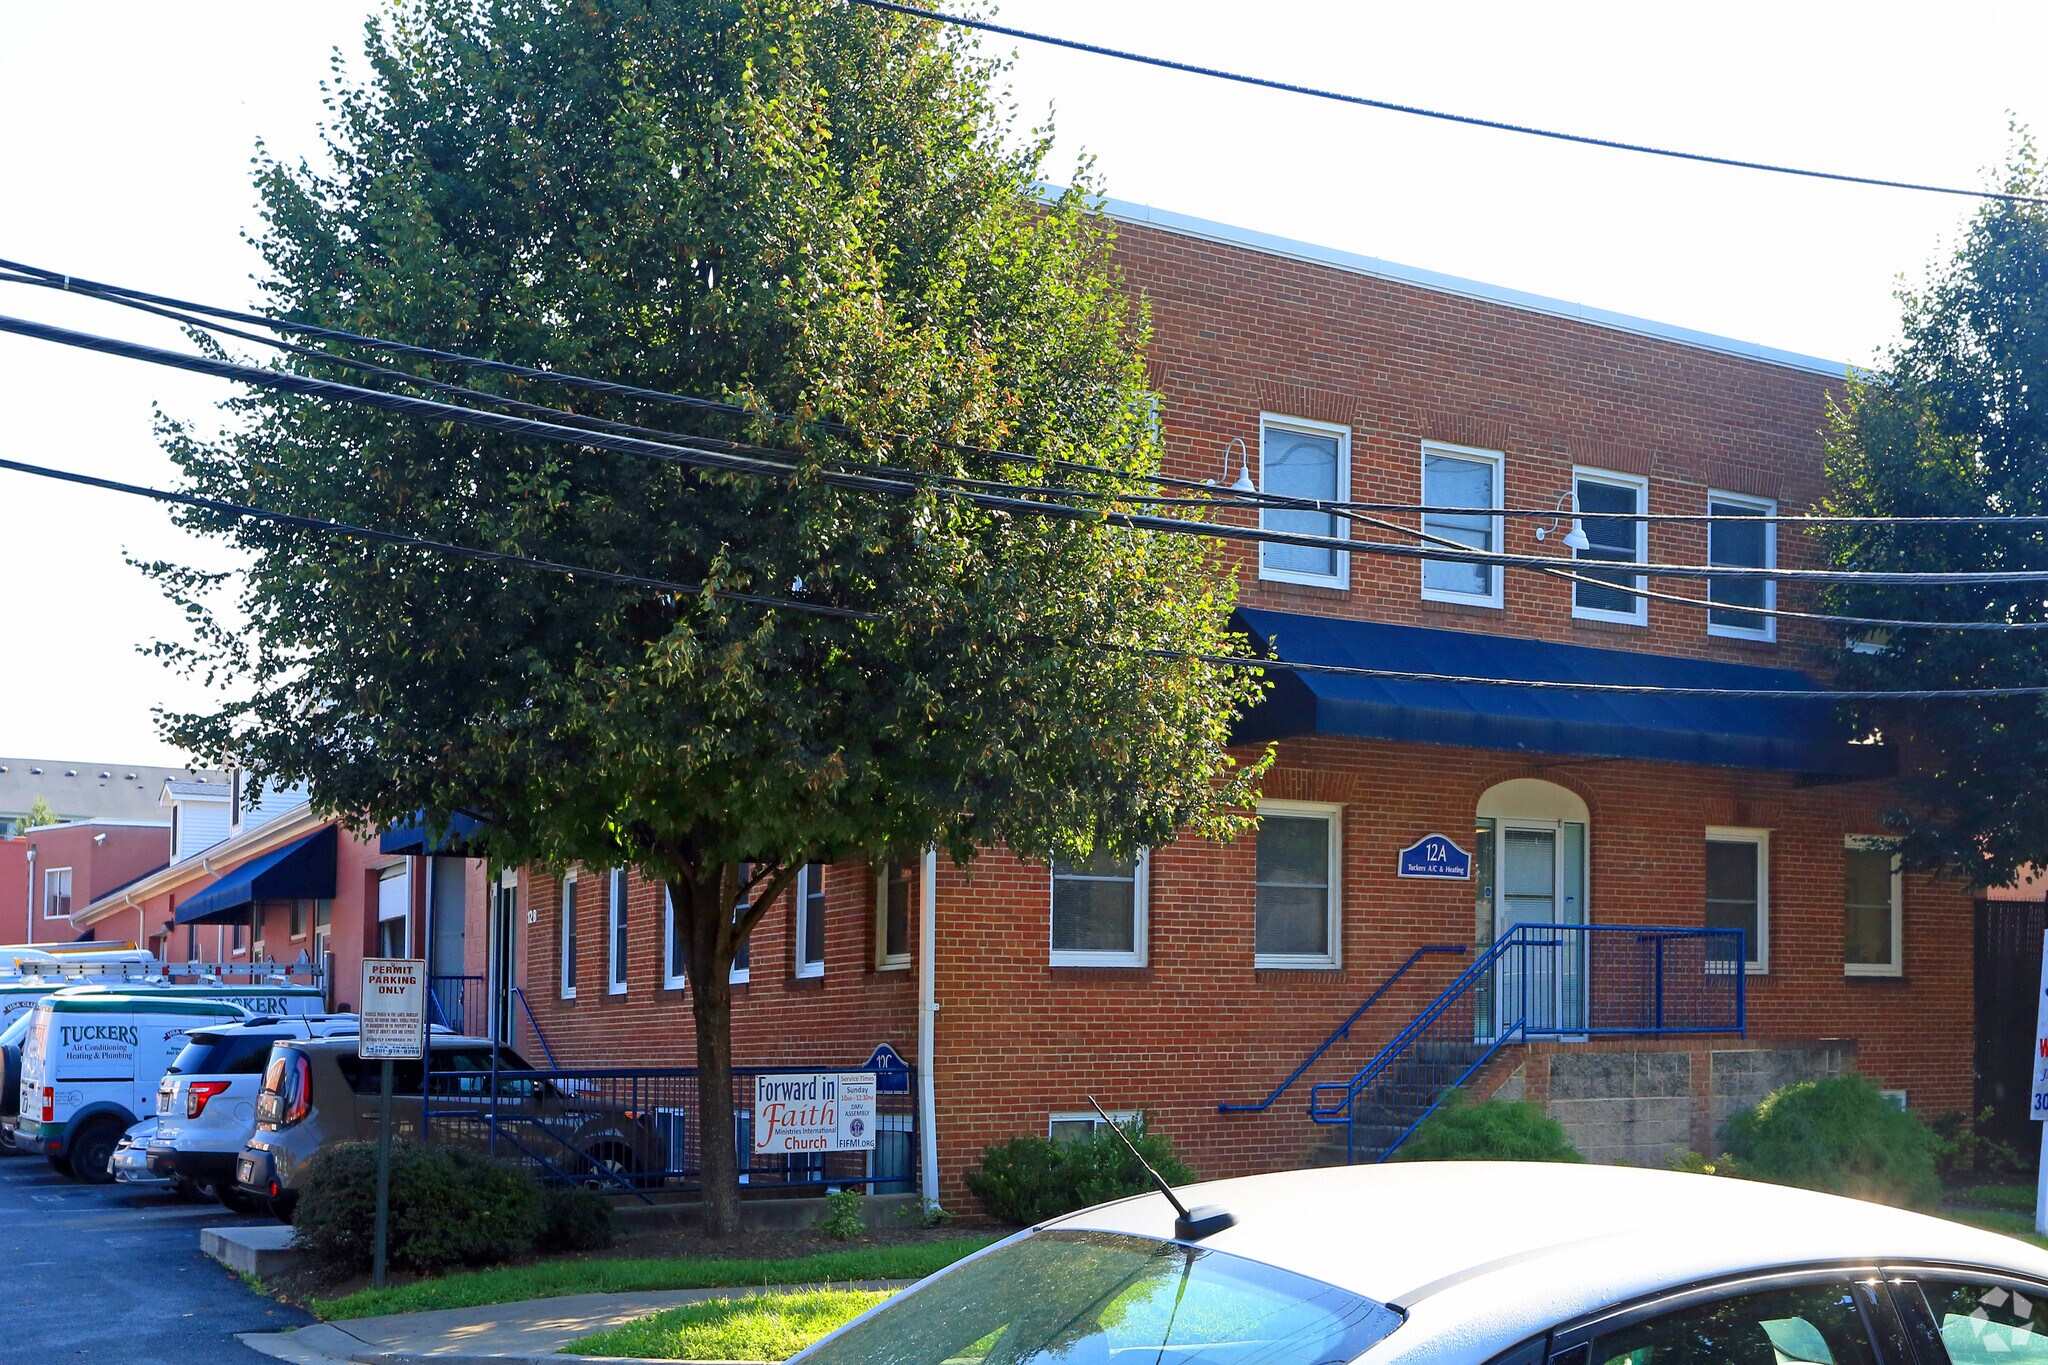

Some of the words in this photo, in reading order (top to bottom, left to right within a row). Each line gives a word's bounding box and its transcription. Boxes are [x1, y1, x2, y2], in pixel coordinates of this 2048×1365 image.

[1426, 843, 1447, 862] 12A
[1408, 864, 1426, 872] Tuckers
[1445, 866, 1464, 875] Heating
[372, 965, 413, 974] PERMIT
[369, 975, 416, 985] PARKING
[378, 986, 405, 994] ONLY
[60, 1025, 138, 1047] TUCKERS
[84, 1044, 127, 1052] Conditioning
[66, 1052, 93, 1061] Heating
[102, 1052, 132, 1060] Plumbing
[758, 1076, 817, 1102] Forward
[822, 1076, 835, 1100] in
[847, 1086, 868, 1094] Sunday
[757, 1100, 836, 1148] Faith
[784, 1135, 827, 1150] Church
